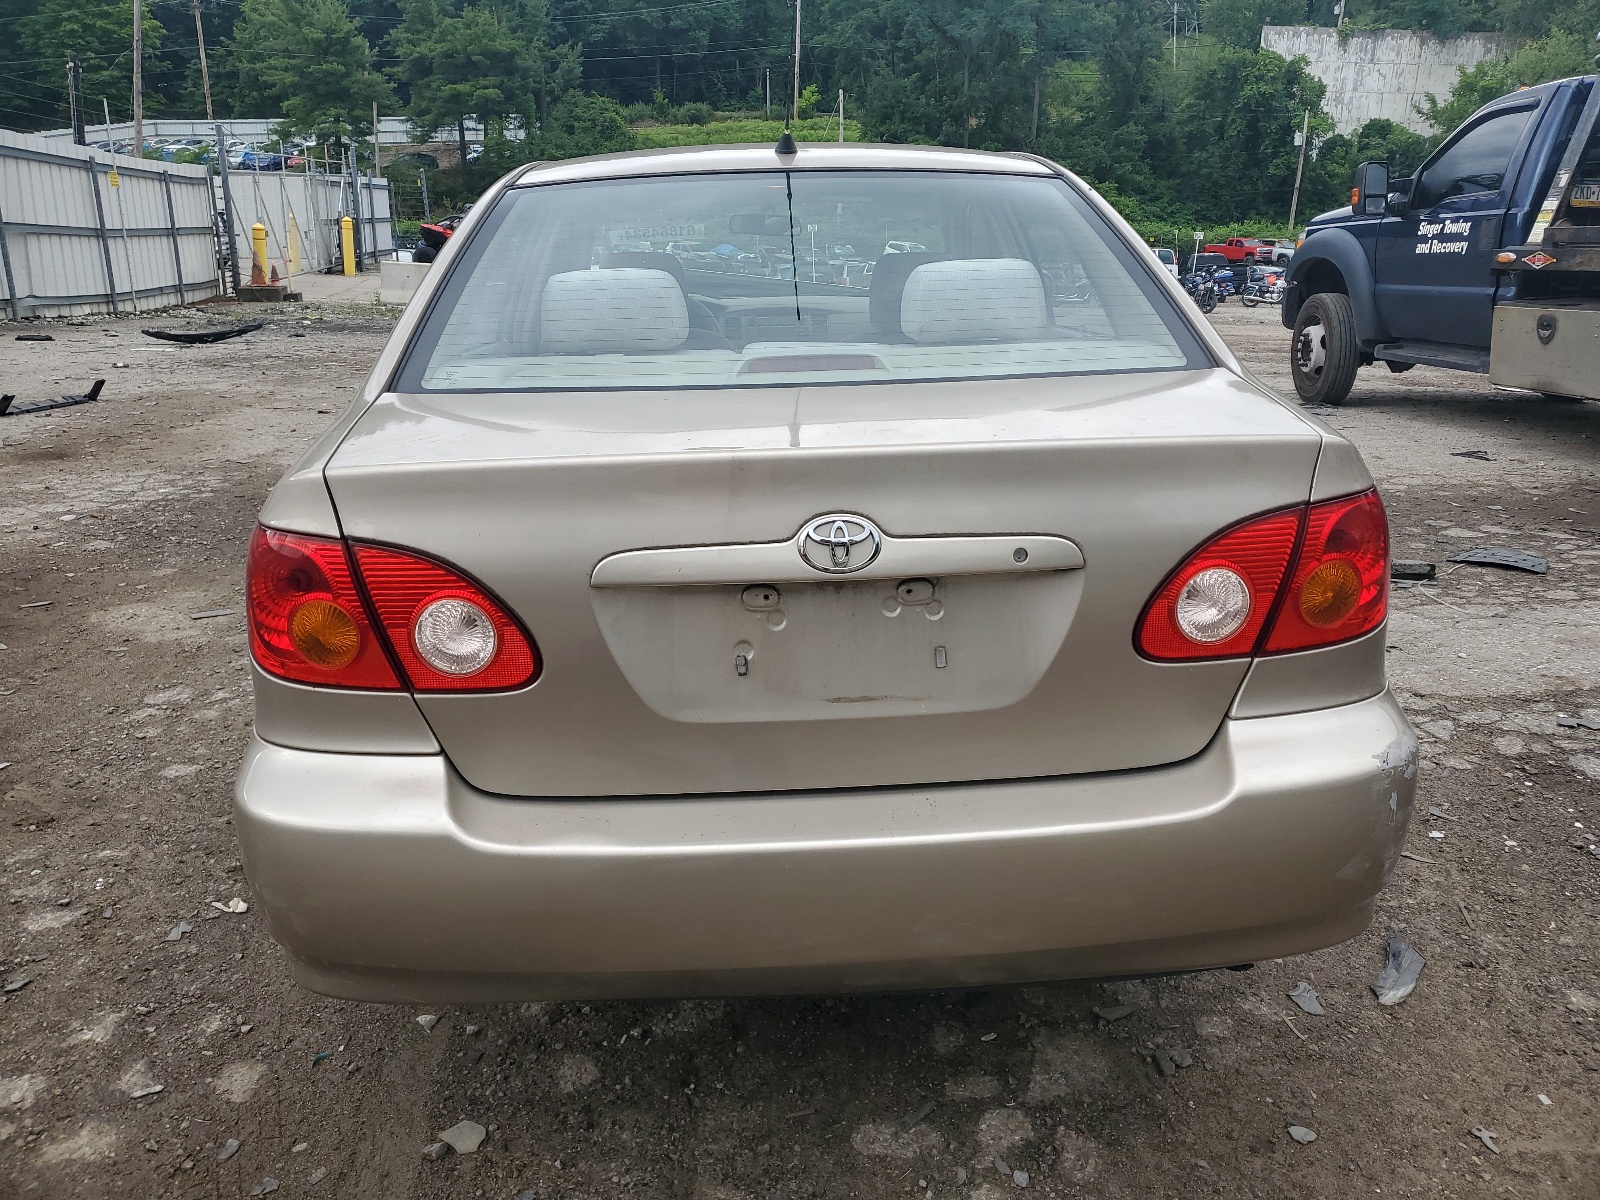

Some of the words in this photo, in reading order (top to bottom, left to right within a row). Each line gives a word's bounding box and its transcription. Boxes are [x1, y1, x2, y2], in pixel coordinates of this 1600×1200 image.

[1418, 221, 1443, 237] Singer
[1443, 219, 1472, 236] Towing
[1415, 240, 1431, 254] and
[1431, 239, 1469, 255] Recovery
